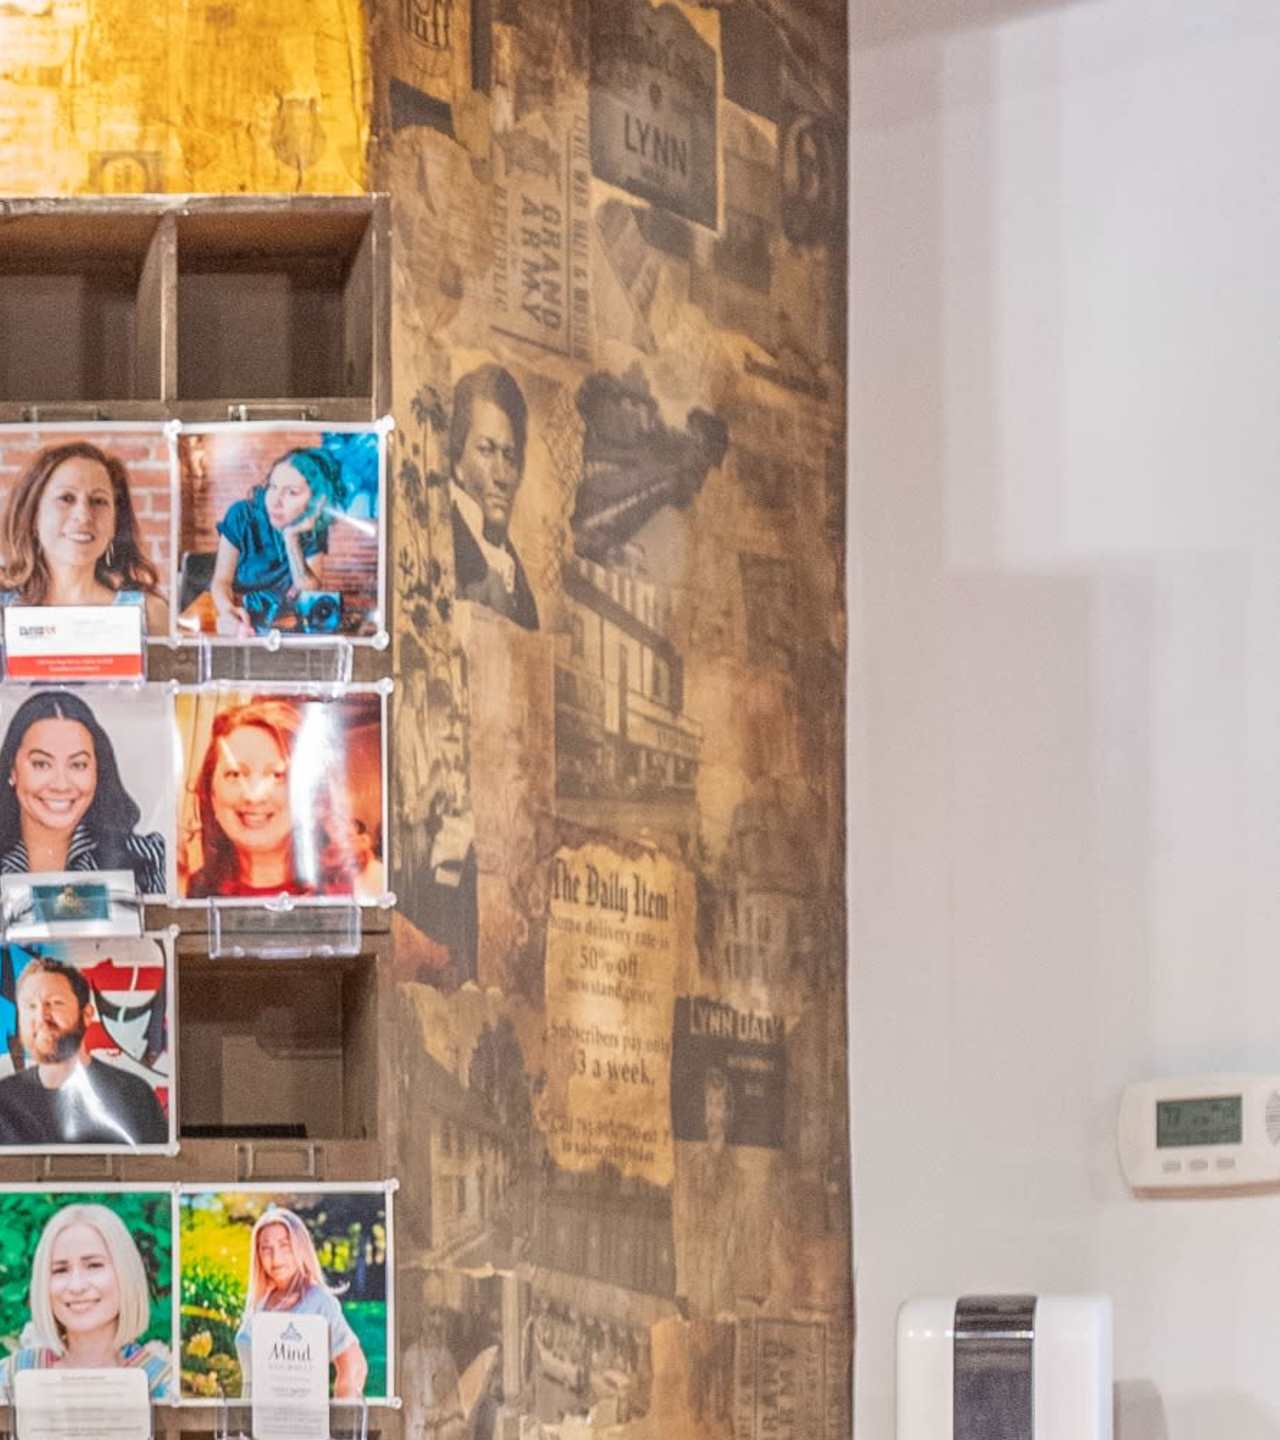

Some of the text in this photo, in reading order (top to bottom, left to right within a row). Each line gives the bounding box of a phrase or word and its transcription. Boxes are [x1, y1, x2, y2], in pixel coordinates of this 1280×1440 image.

[624, 110, 688, 177] LYNN
[520, 194, 542, 324] ARMY
[542, 202, 563, 331] GRAND
[552, 857, 580, 903] The
[586, 863, 629, 923] Daily
[268, 1342, 312, 1362] Mind
